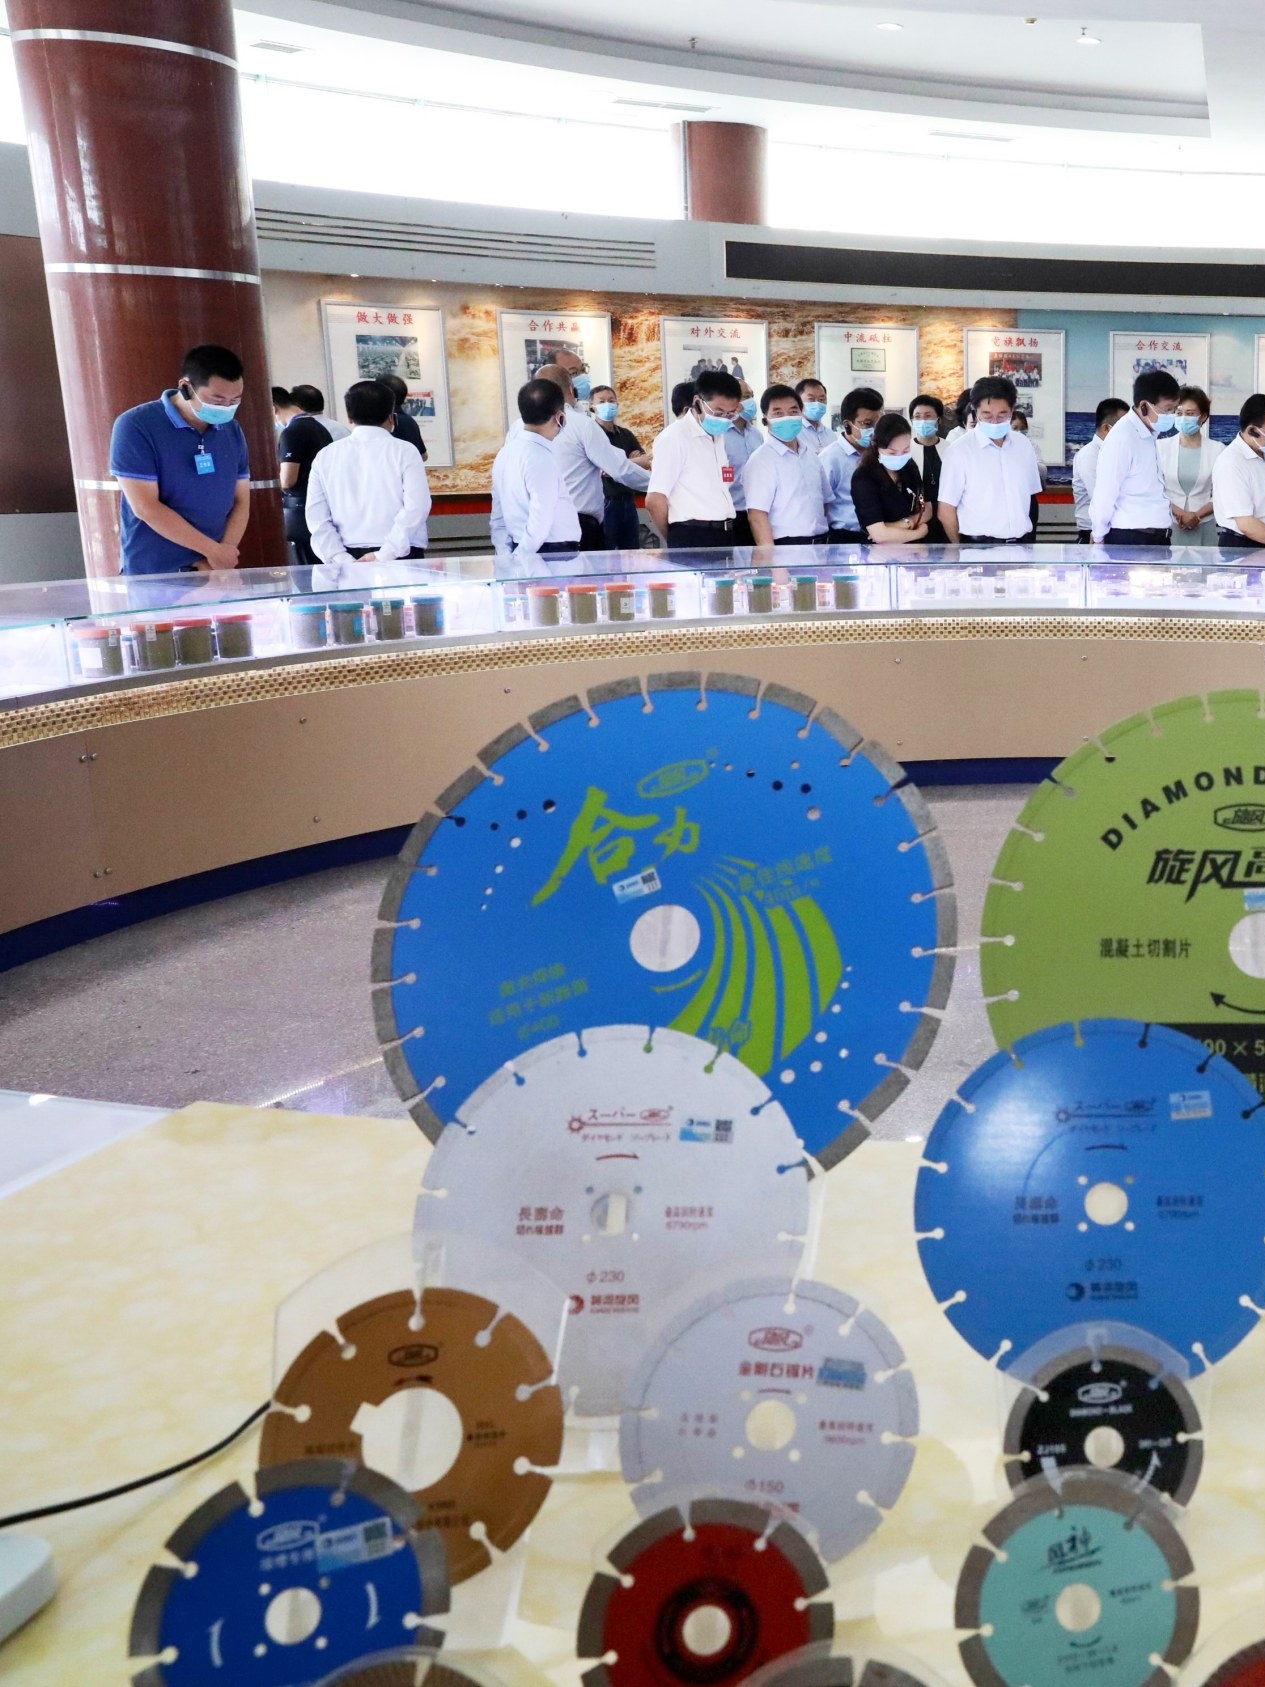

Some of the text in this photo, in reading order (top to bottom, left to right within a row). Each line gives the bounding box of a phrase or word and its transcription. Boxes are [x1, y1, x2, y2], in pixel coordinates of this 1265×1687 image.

[356, 311, 413, 326] 做大做强
[690, 327, 741, 340] 对外交流
[844, 331, 892, 343] 中流砥柱
[992, 336, 1039, 348] 党旗飘扬
[1135, 340, 1182, 351] 合作交流
[1100, 937, 1192, 959] 混凝土切割片
[1203, 1039, 1227, 1056] 00
